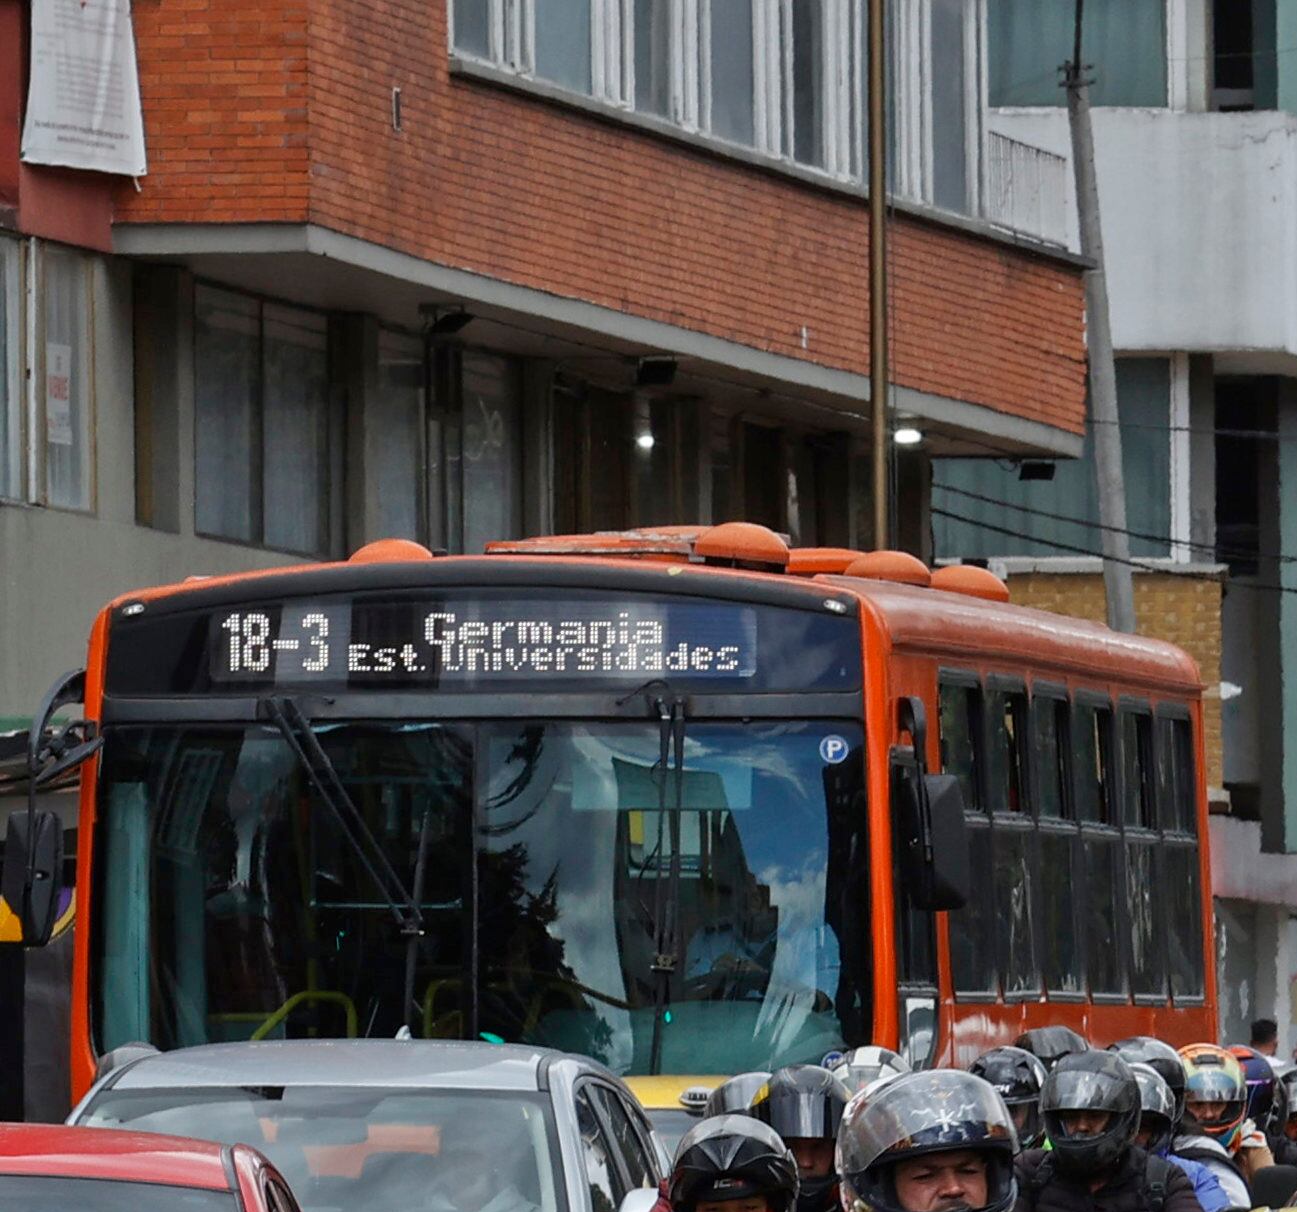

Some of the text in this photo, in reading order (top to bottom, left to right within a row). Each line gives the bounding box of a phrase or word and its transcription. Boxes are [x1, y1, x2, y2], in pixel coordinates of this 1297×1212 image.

[222, 613, 329, 672] 18-3
[424, 612, 663, 645] Germania
[349, 643, 739, 672] Est. Universidades
